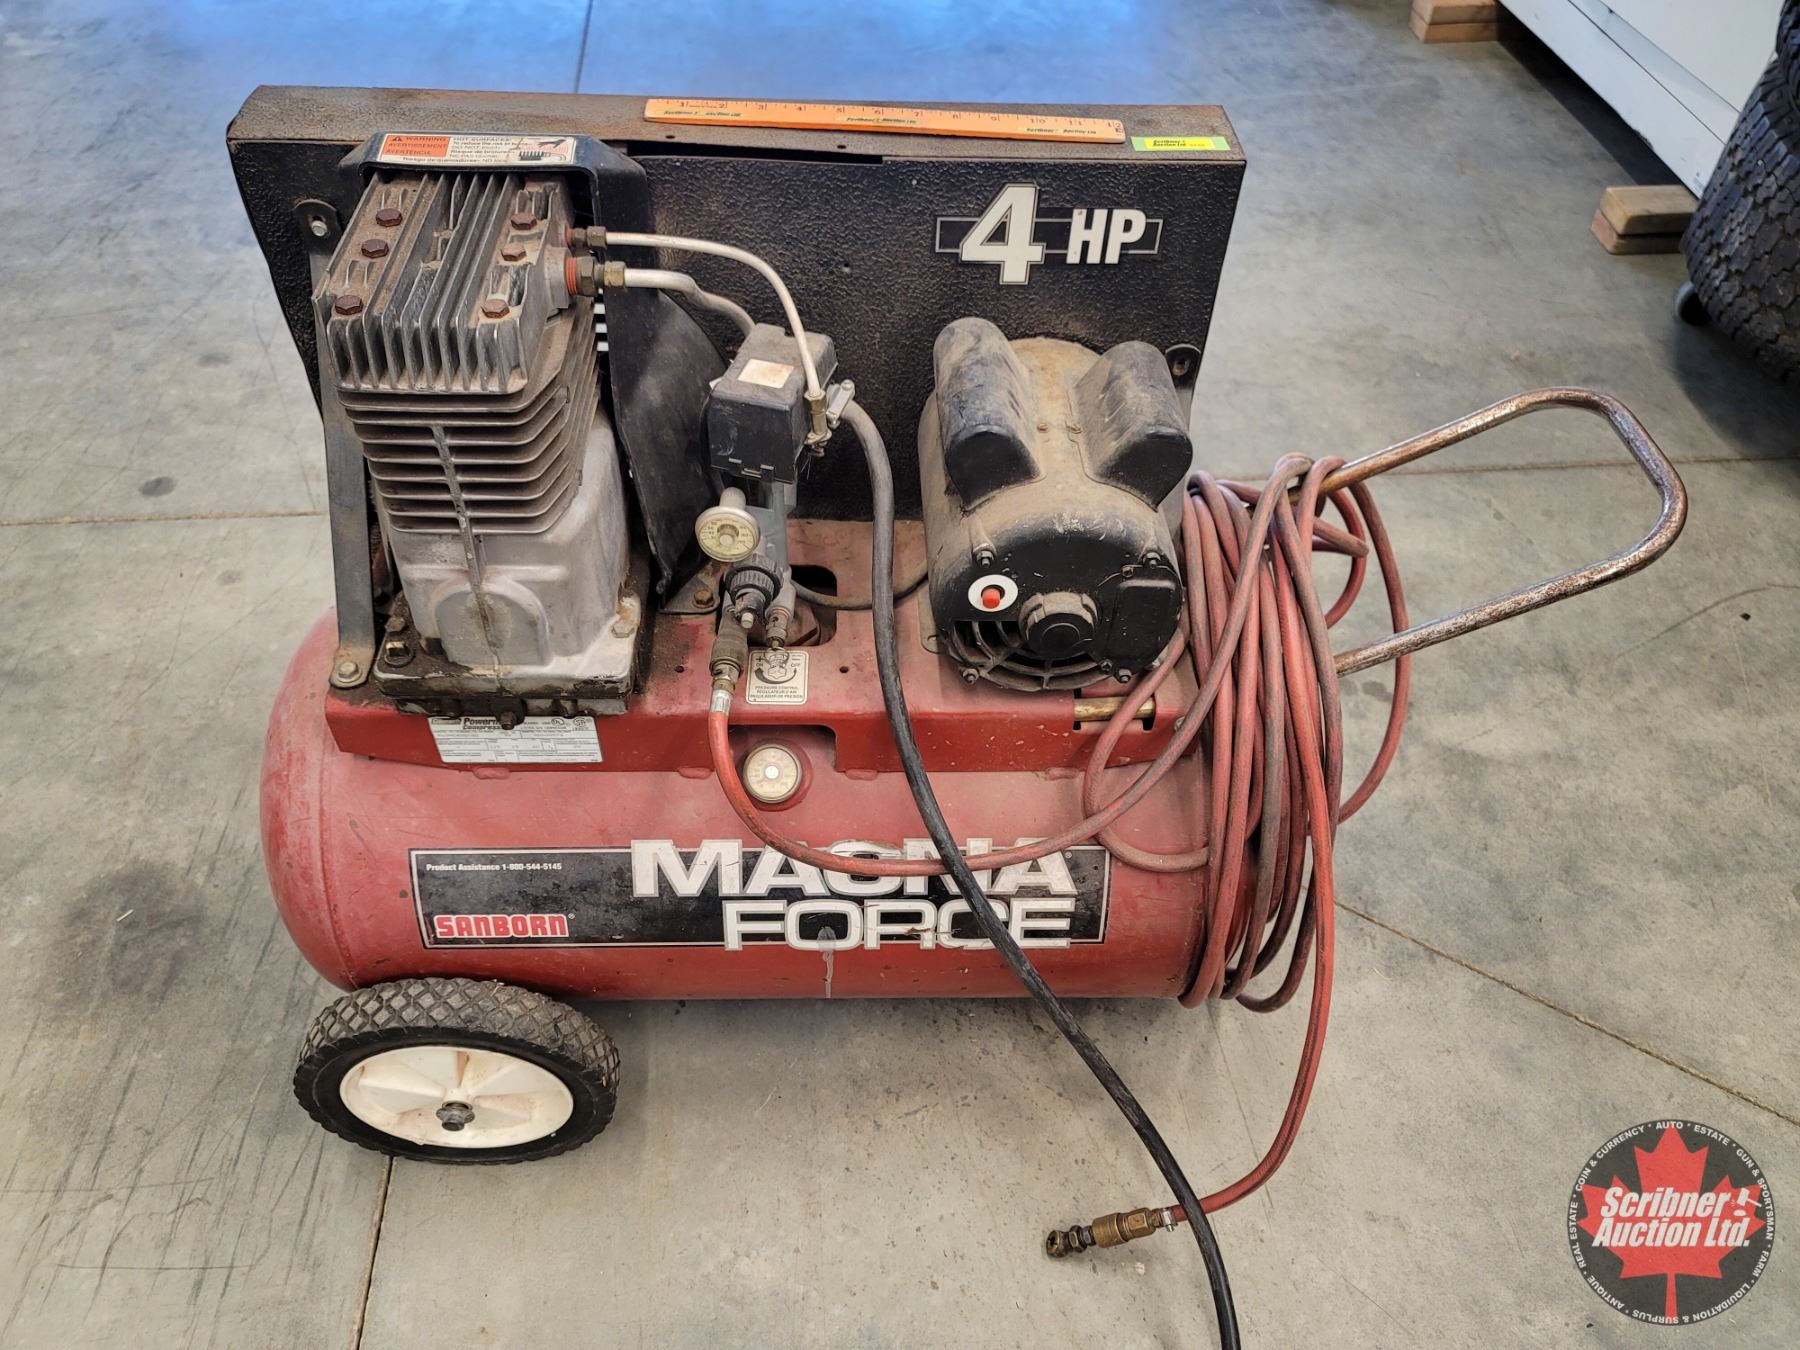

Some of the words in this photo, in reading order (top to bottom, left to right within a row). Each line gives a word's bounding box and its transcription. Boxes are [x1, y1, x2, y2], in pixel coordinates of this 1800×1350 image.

[960, 182, 1046, 285] 4
[1066, 208, 1147, 264] HP
[426, 863, 457, 872] Product
[458, 863, 500, 871] Assistance
[631, 838, 1078, 897] MAGNA
[433, 913, 569, 938] SANBORN
[722, 898, 1076, 950] FORCE
